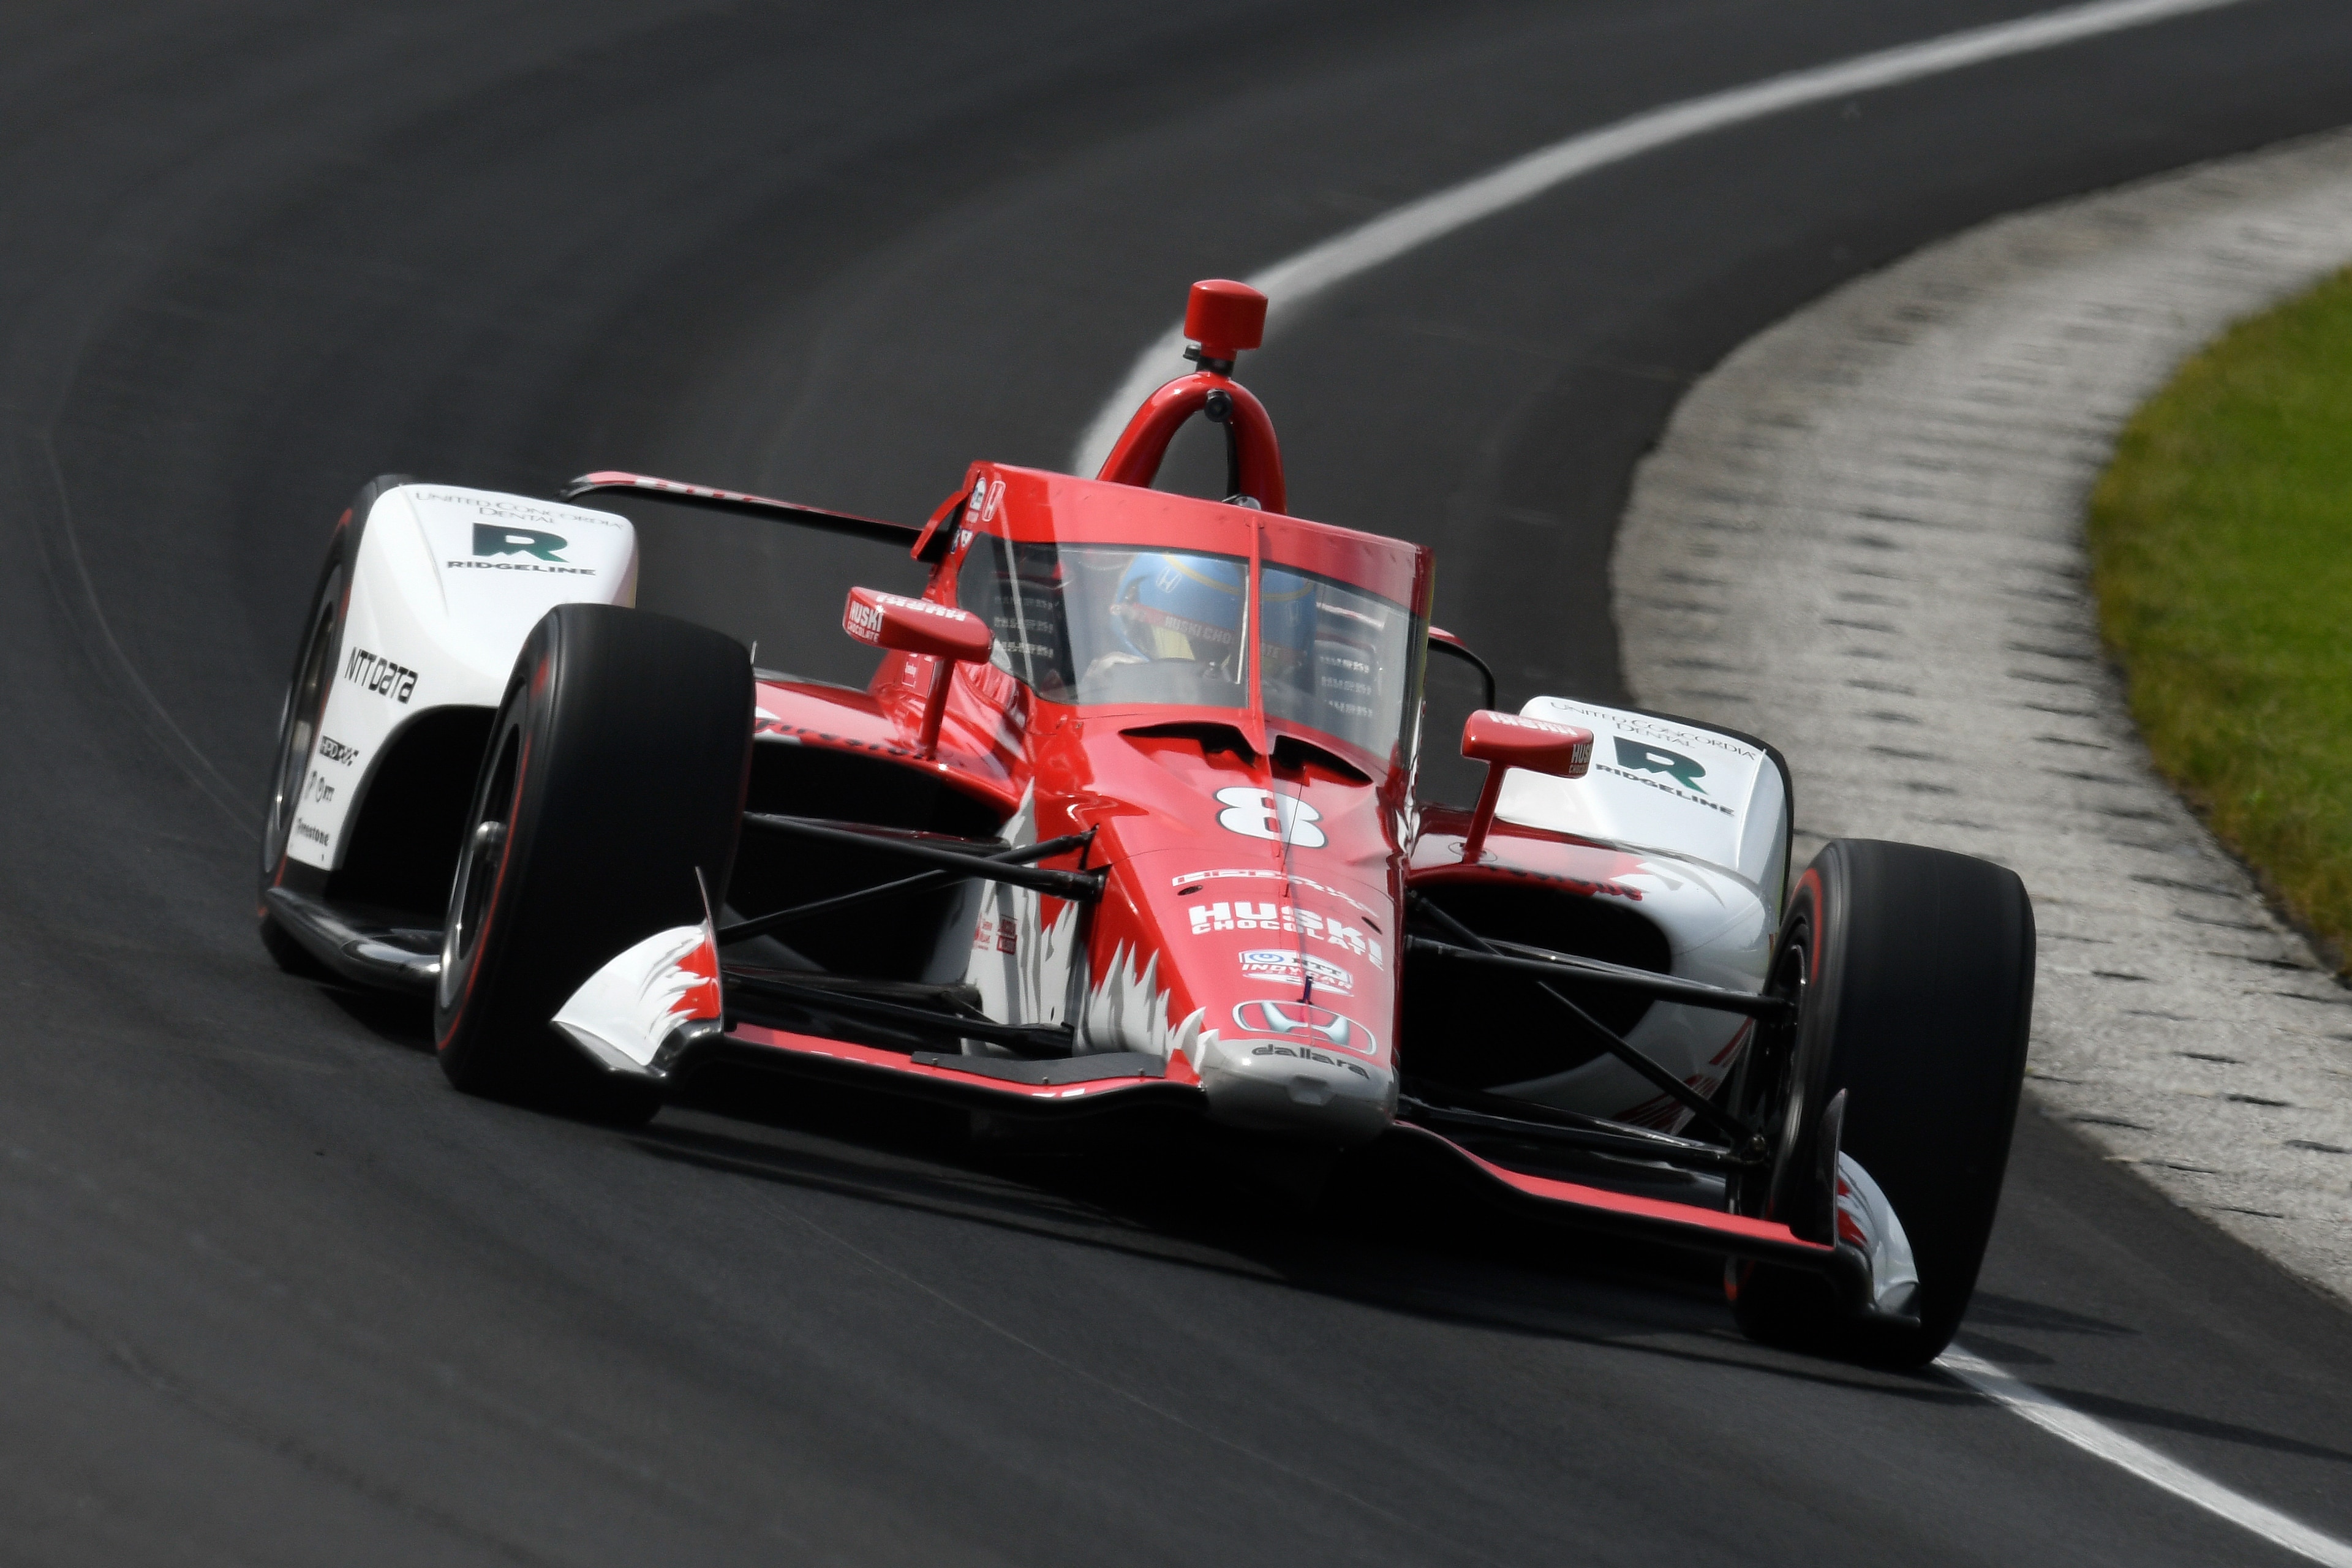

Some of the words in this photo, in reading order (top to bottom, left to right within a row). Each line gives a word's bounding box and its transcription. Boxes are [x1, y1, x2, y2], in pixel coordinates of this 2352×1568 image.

[415, 492, 491, 508] UNITED
[479, 507, 554, 524] DENTAL
[447, 560, 598, 576] RIDGELINE
[1616, 722, 1696, 749] DENTAL
[1631, 719, 1756, 761] CONCORDIA
[1595, 763, 1736, 818] RIDGELINE
[1213, 786, 1329, 848] 8
[1188, 902, 1383, 964] HUSKI
[1251, 1043, 1370, 1080] dallara
